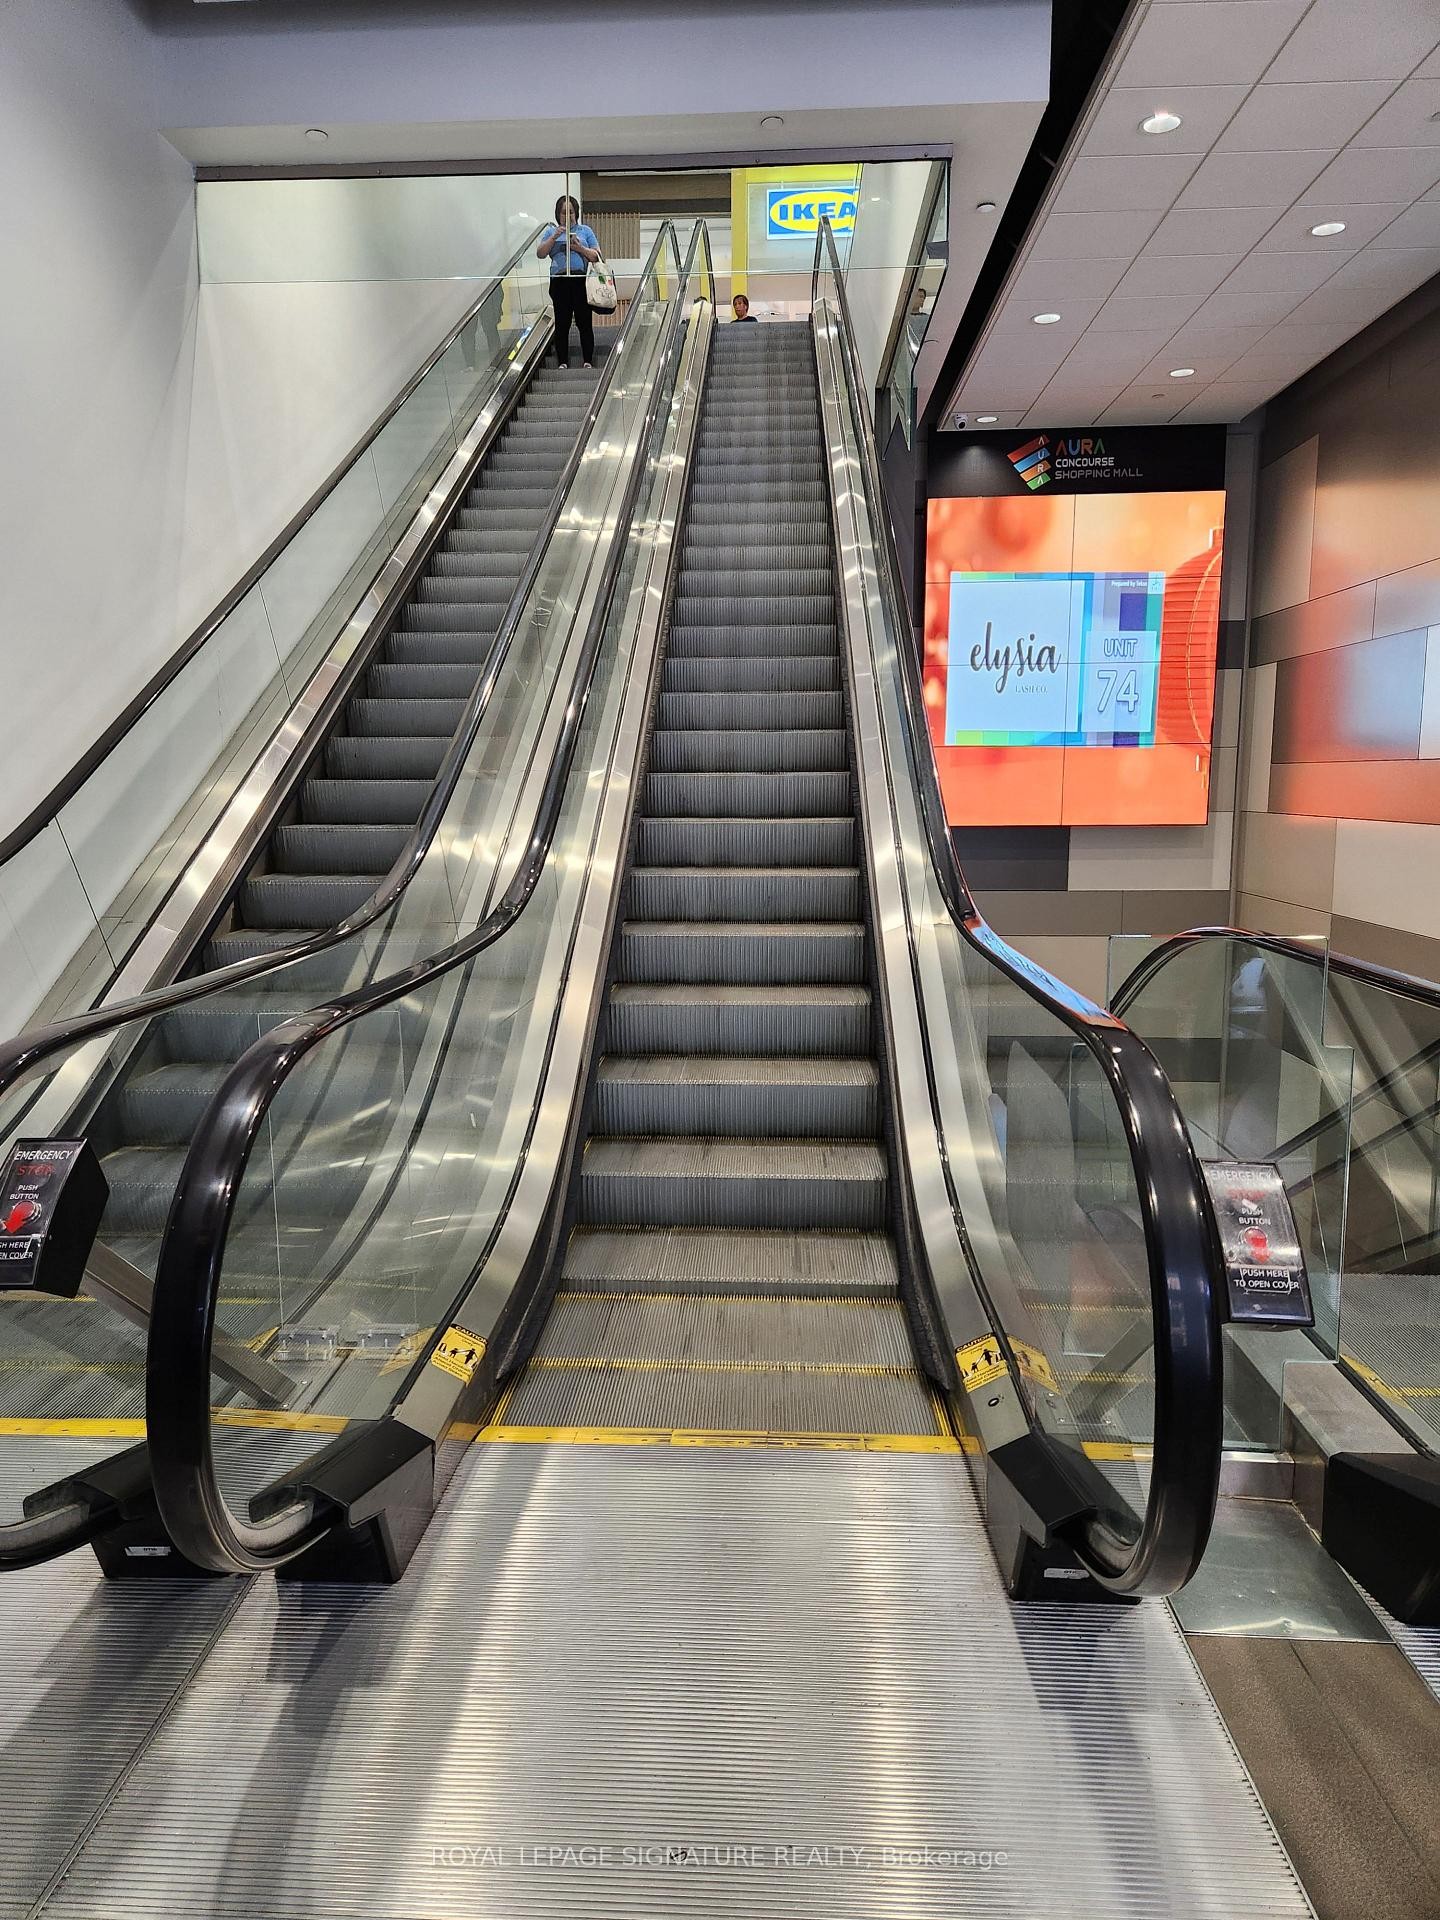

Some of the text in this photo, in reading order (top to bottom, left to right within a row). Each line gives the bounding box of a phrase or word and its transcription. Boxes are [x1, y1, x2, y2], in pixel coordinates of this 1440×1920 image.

[778, 201, 857, 221] IKEA
[1055, 438, 1106, 456] AURA
[1055, 457, 1115, 468] CONCOURSE
[1055, 467, 1144, 480] SHOPPING MALL
[1103, 638, 1138, 657] UNIT
[970, 622, 1062, 694] elysia
[1097, 669, 1139, 712] 74
[14, 1150, 73, 1160] EMERGENCY
[17, 1163, 54, 1176] STOP
[1210, 1169, 1272, 1180] EMERGENCY
[9, 1192, 40, 1200] BUTTON
[1241, 1207, 1263, 1216] PUSH
[1238, 1216, 1271, 1226] BUTTON
[9, 1241, 30, 1249] HERE
[1242, 1268, 1289, 1278] PUSH HERE
[1233, 1279, 1300, 1290] TO OPEN COVER
[455, 1325, 488, 1345] CAUTION
[956, 1333, 992, 1352] CAUTION
